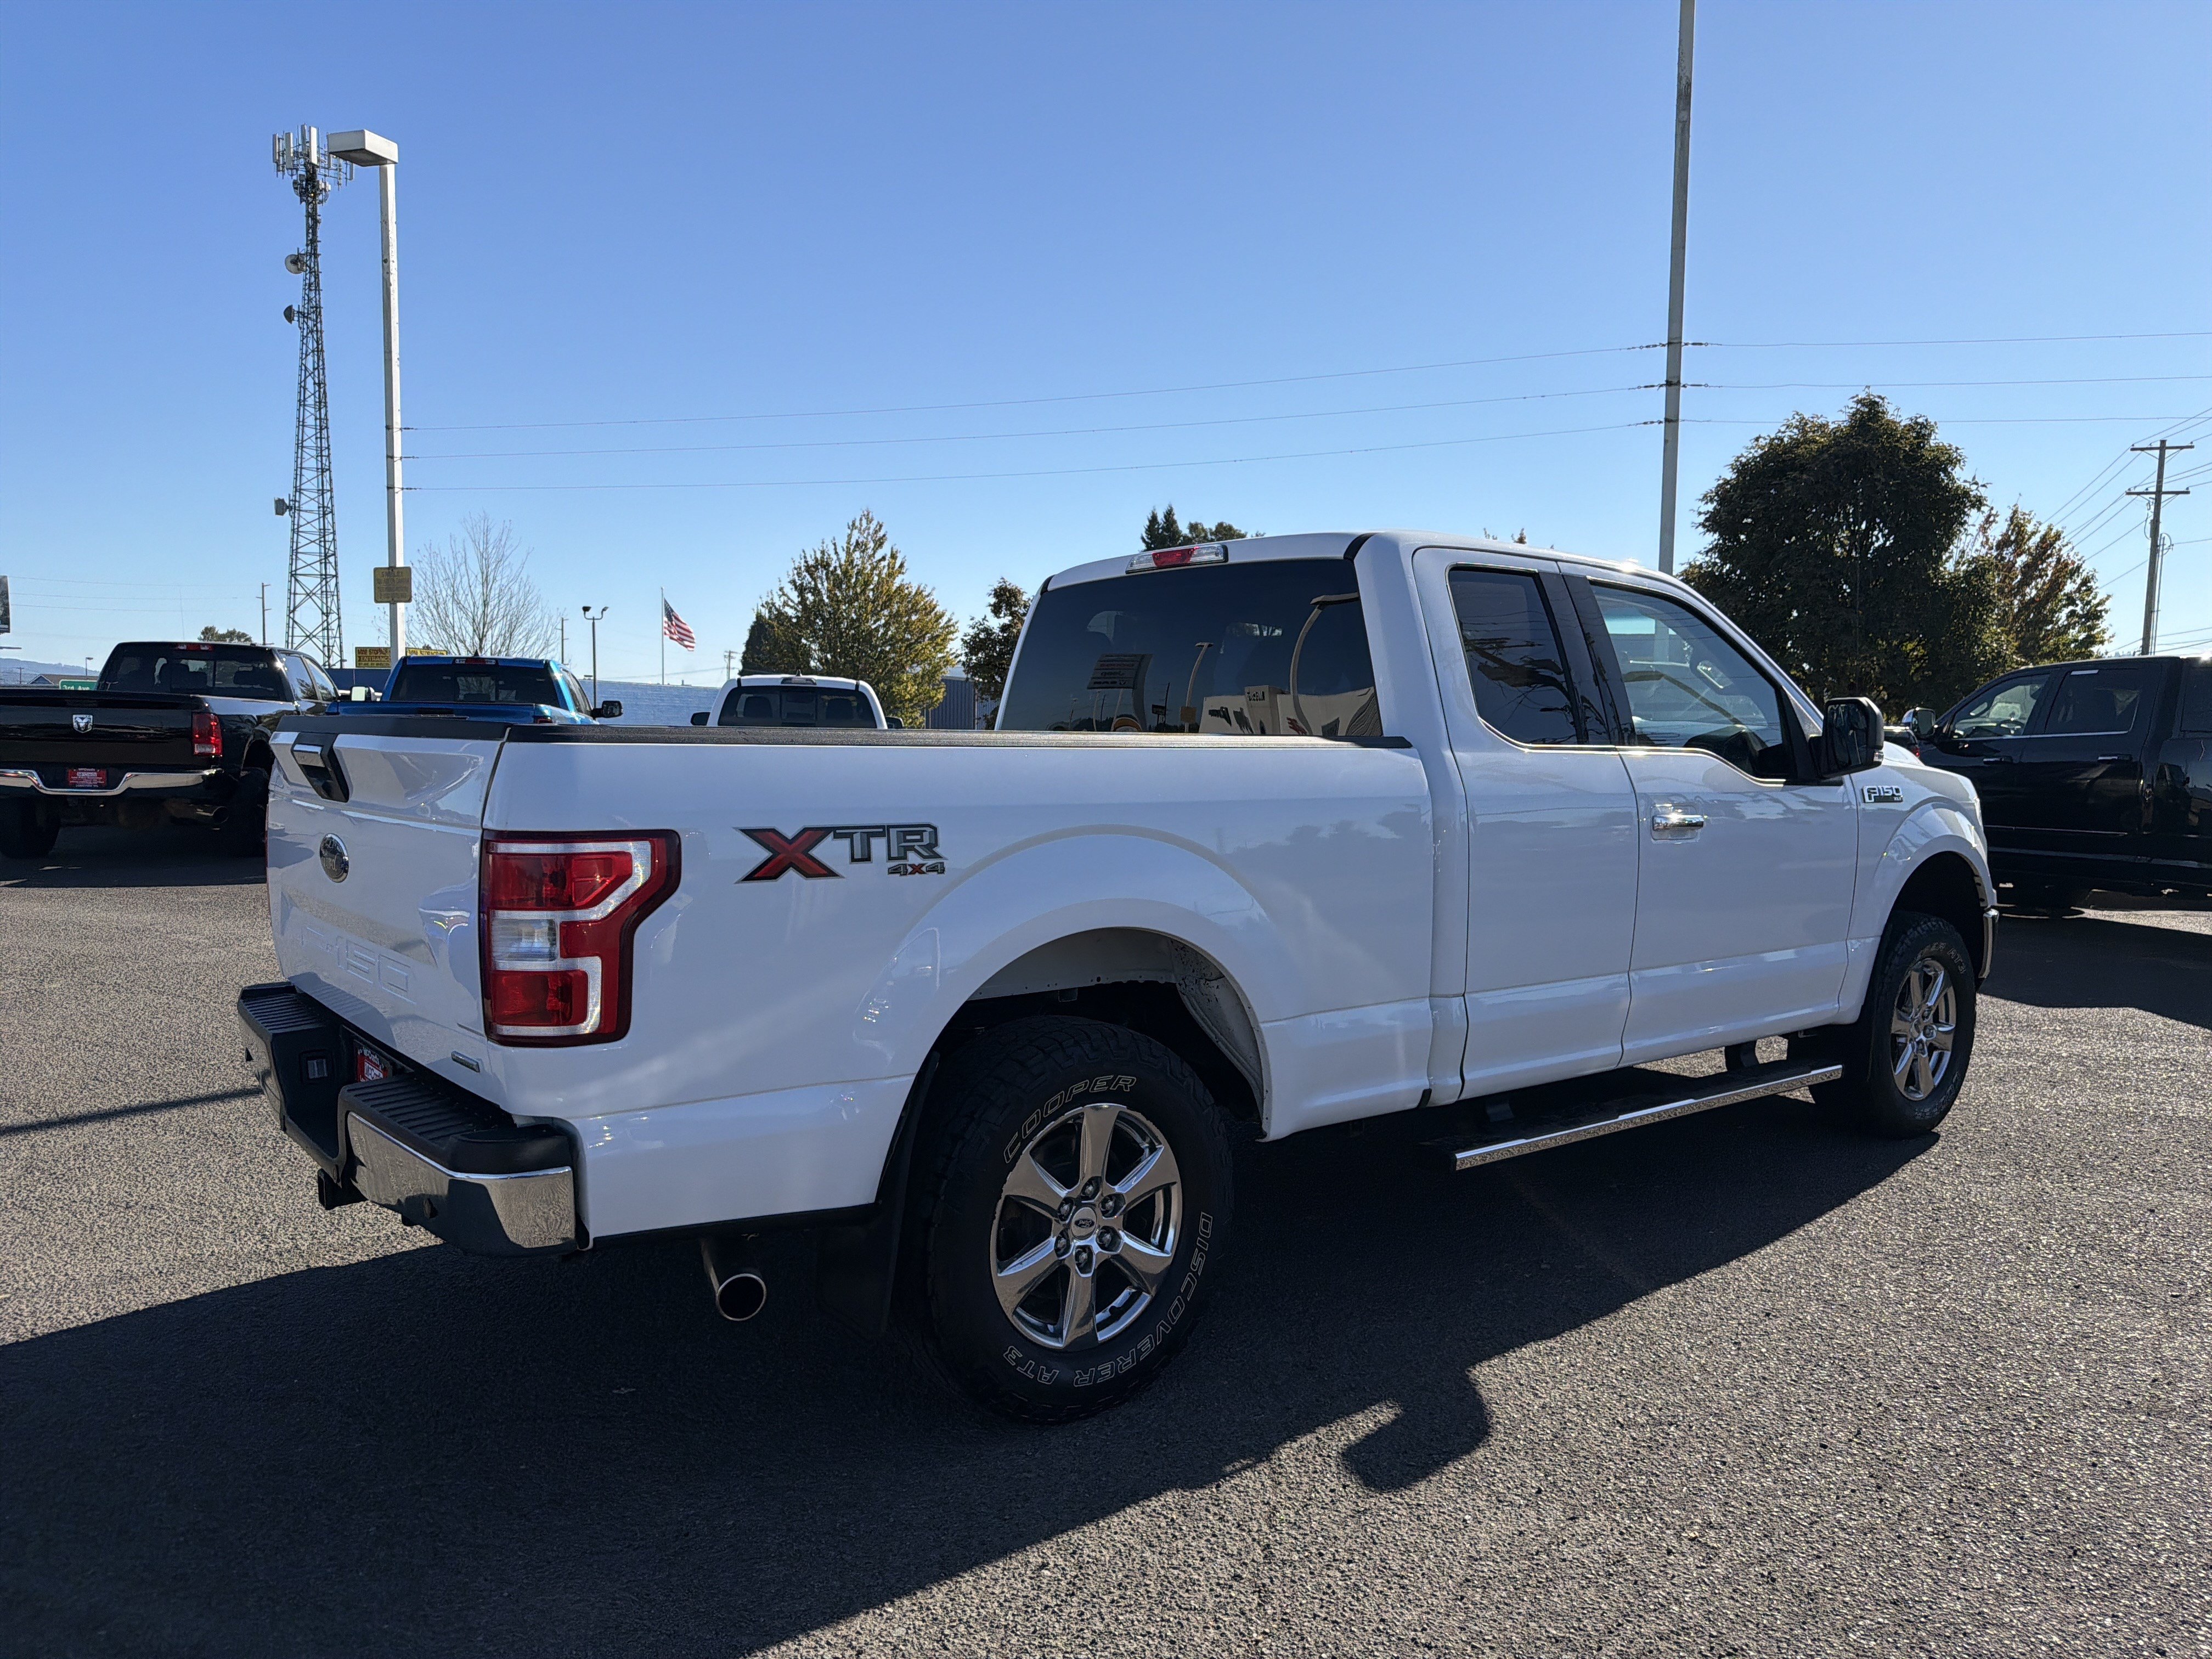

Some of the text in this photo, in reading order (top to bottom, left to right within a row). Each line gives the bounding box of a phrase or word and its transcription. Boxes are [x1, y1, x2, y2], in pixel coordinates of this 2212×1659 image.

[732, 822, 948, 884] XTR
[1003, 1075, 1137, 1164] COOPER
[1003, 1211, 1213, 1387] DISCOVERER AT3
